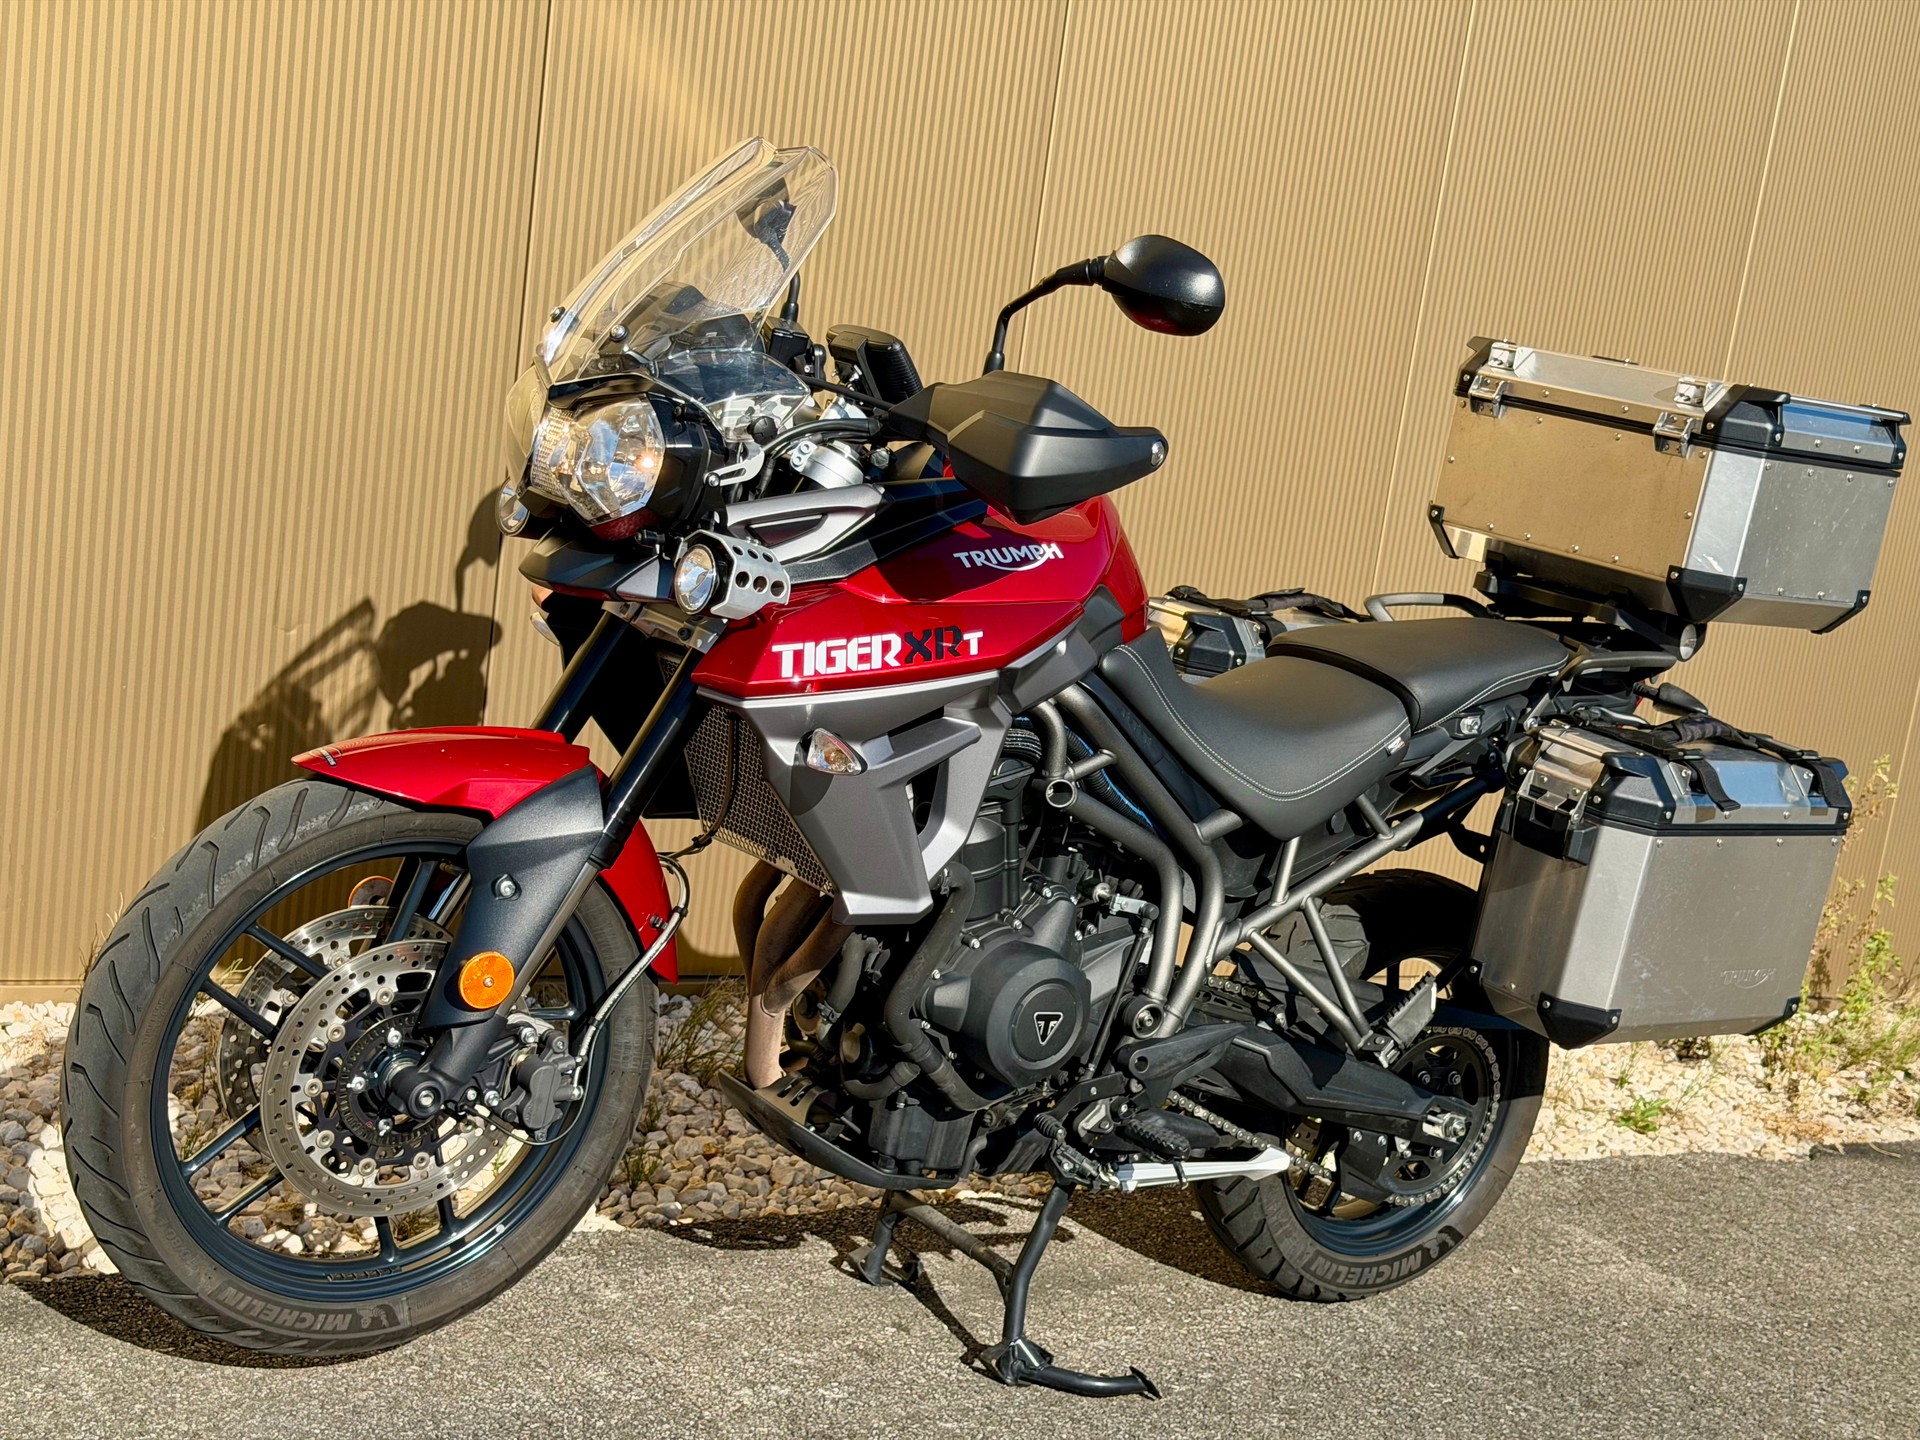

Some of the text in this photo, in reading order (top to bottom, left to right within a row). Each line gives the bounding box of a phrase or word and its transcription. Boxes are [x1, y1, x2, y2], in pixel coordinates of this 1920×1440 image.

[953, 542, 1064, 571] TRIUMPH
[771, 632, 902, 678] TIGER
[1310, 1250, 1422, 1286] MICHELIN
[217, 1286, 353, 1331] MICHELIN
